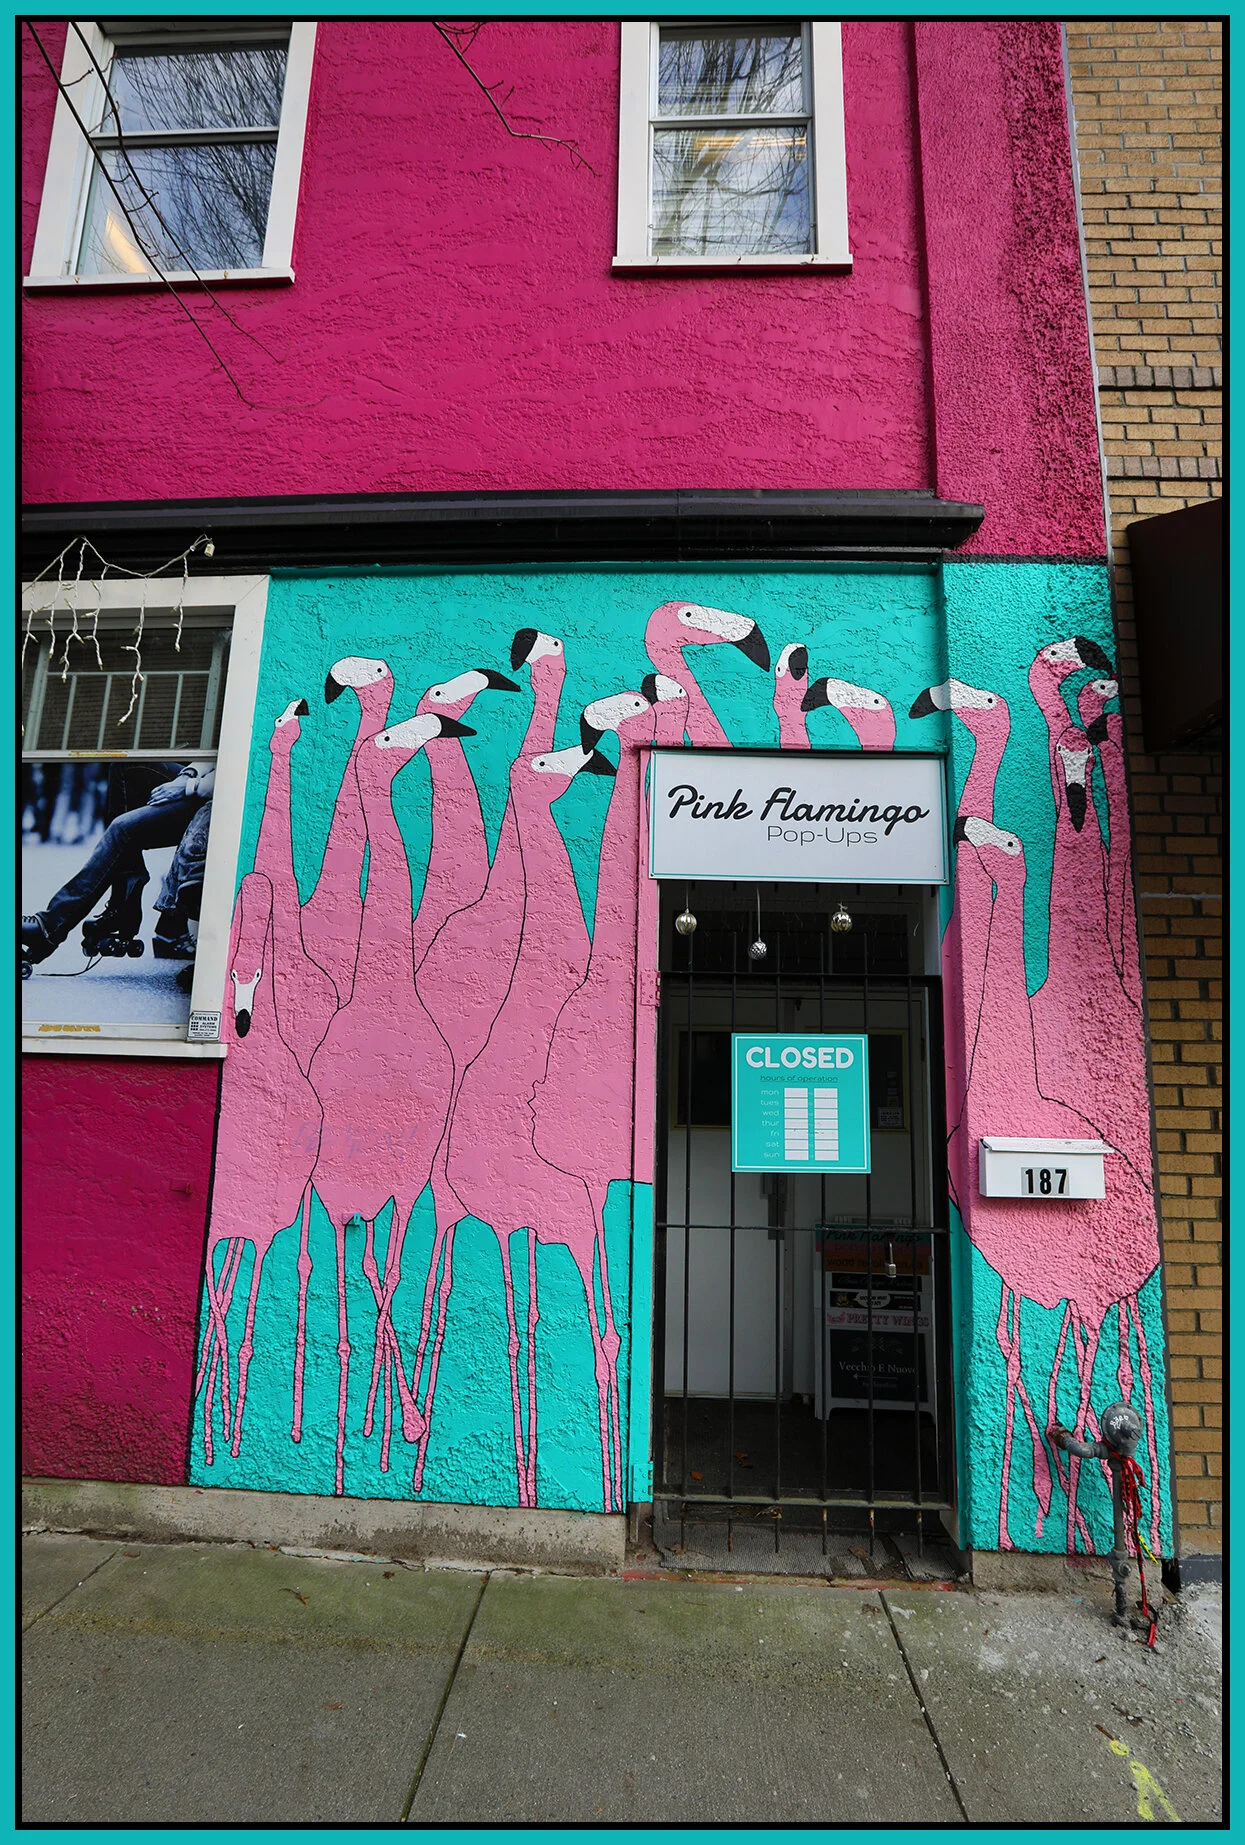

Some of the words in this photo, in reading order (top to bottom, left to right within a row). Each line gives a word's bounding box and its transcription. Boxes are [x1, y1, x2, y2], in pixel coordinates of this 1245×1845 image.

[667, 784, 753, 820] Pink
[760, 787, 930, 836] Flamingo
[767, 825, 878, 847] Pop-Ups
[745, 1046, 854, 1069] CLOSED
[798, 1074, 839, 1083] operation
[1025, 1168, 1067, 1195] 187
